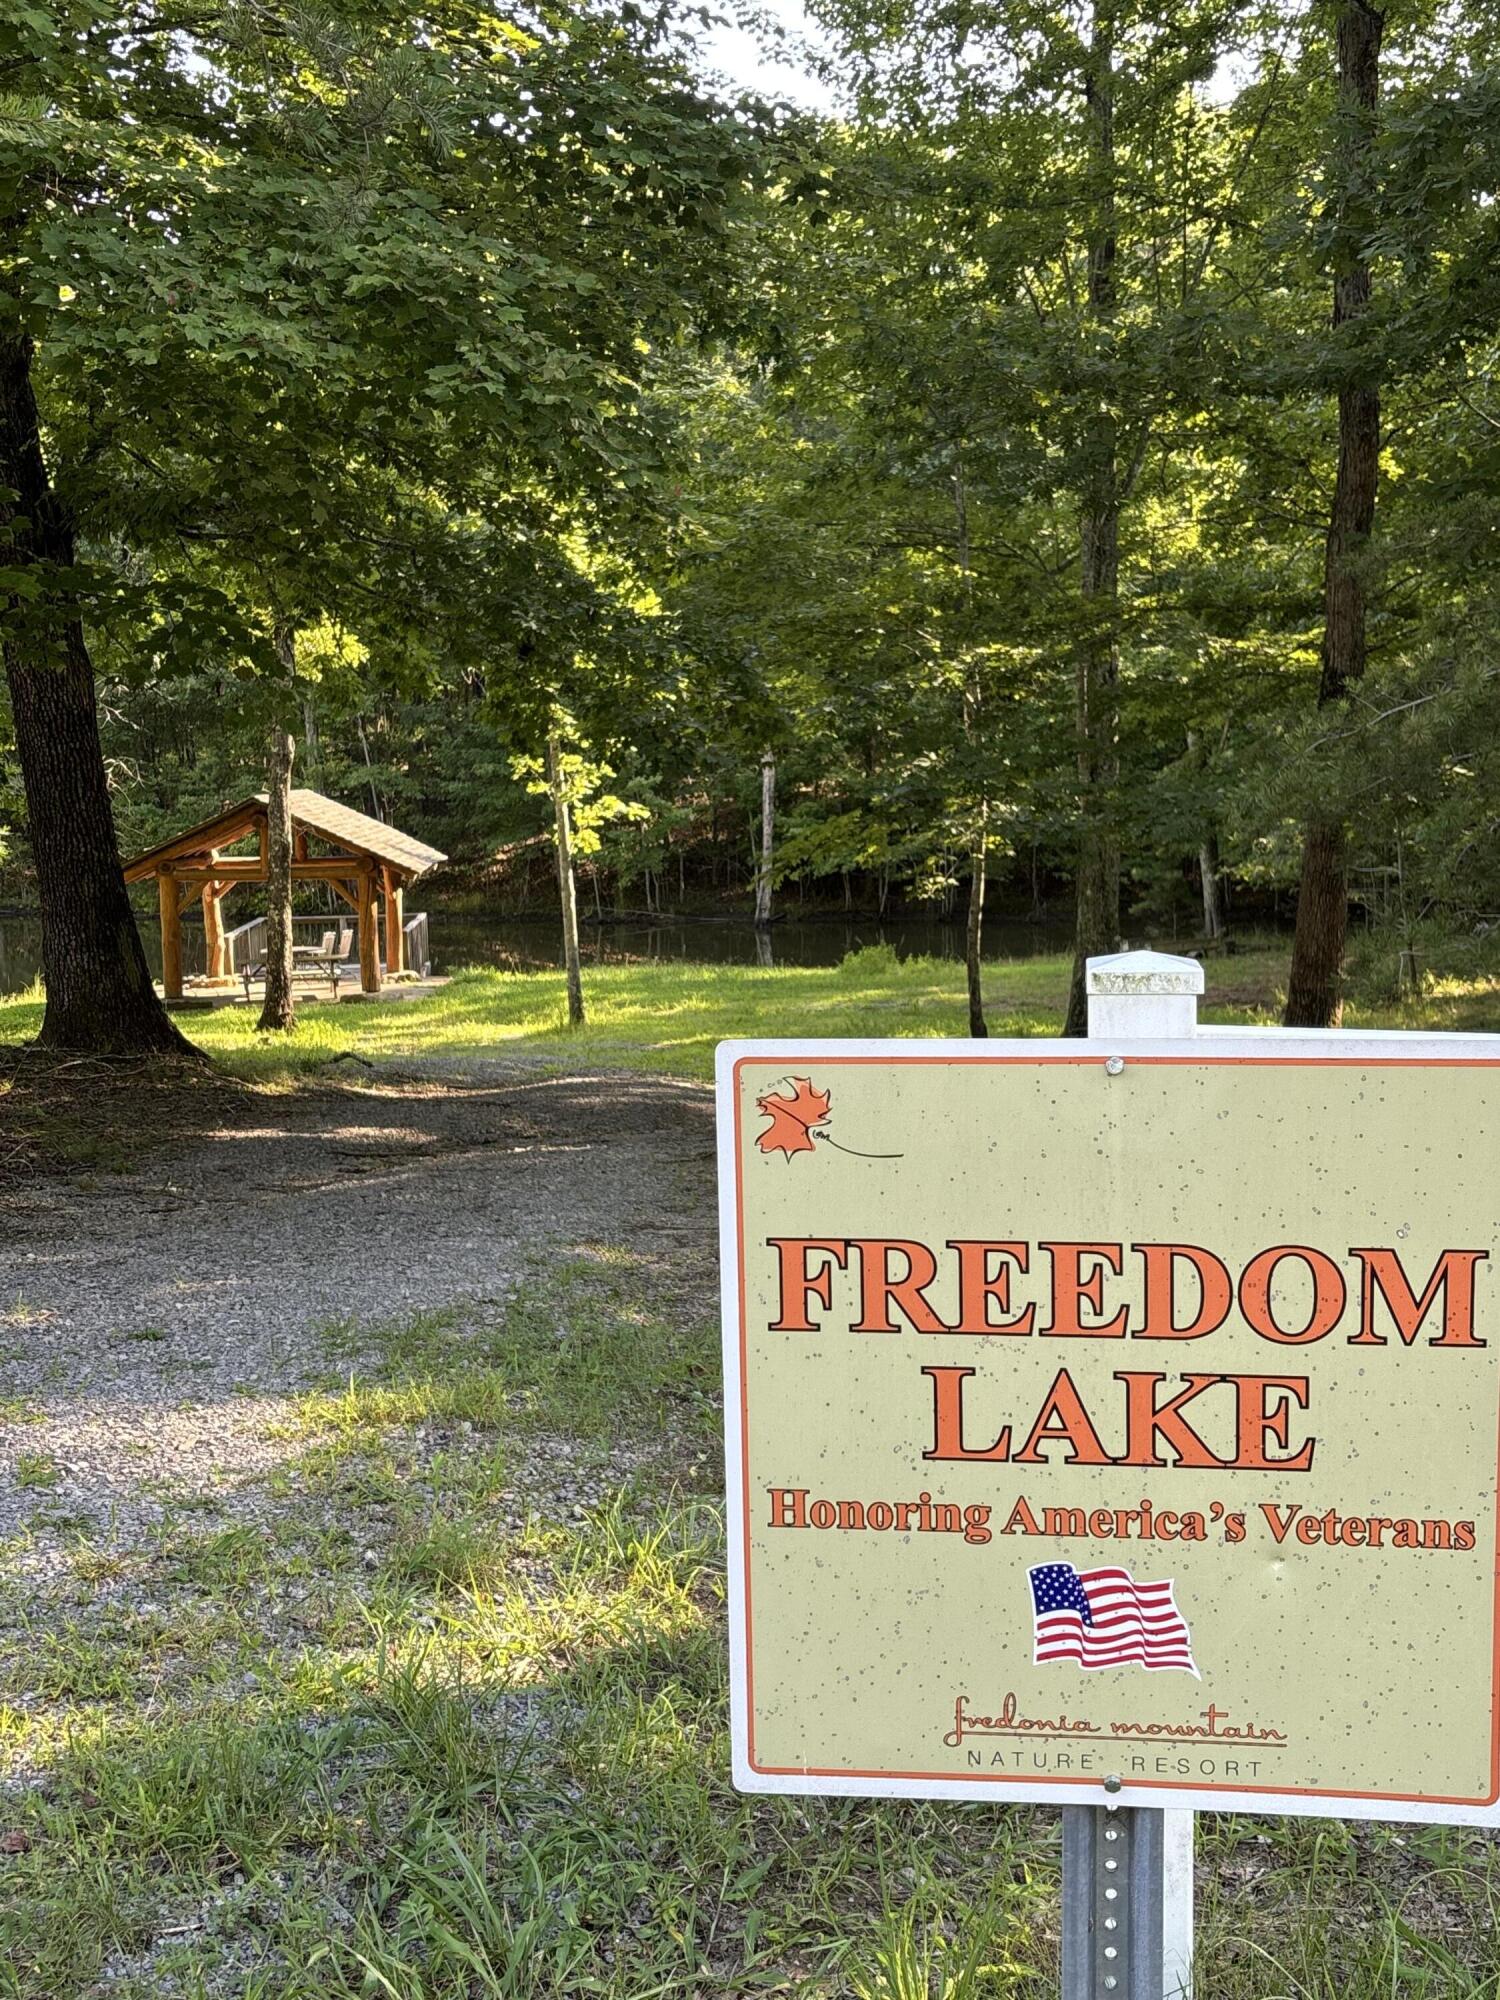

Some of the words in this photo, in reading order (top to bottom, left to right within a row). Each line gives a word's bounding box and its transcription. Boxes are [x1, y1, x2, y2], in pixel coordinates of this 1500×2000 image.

[766, 1237, 1490, 1348] FREEDOM
[921, 1365, 1317, 1472] LAKE
[766, 1488, 993, 1545] Honoring
[1000, 1495, 1247, 1543] America's
[1258, 1503, 1476, 1551] Veterans
[943, 1691, 1101, 1748] fredonia
[1110, 1703, 1288, 1741] mountain
[967, 1750, 1094, 1771] NATURE
[1131, 1756, 1263, 1778] RESORT
